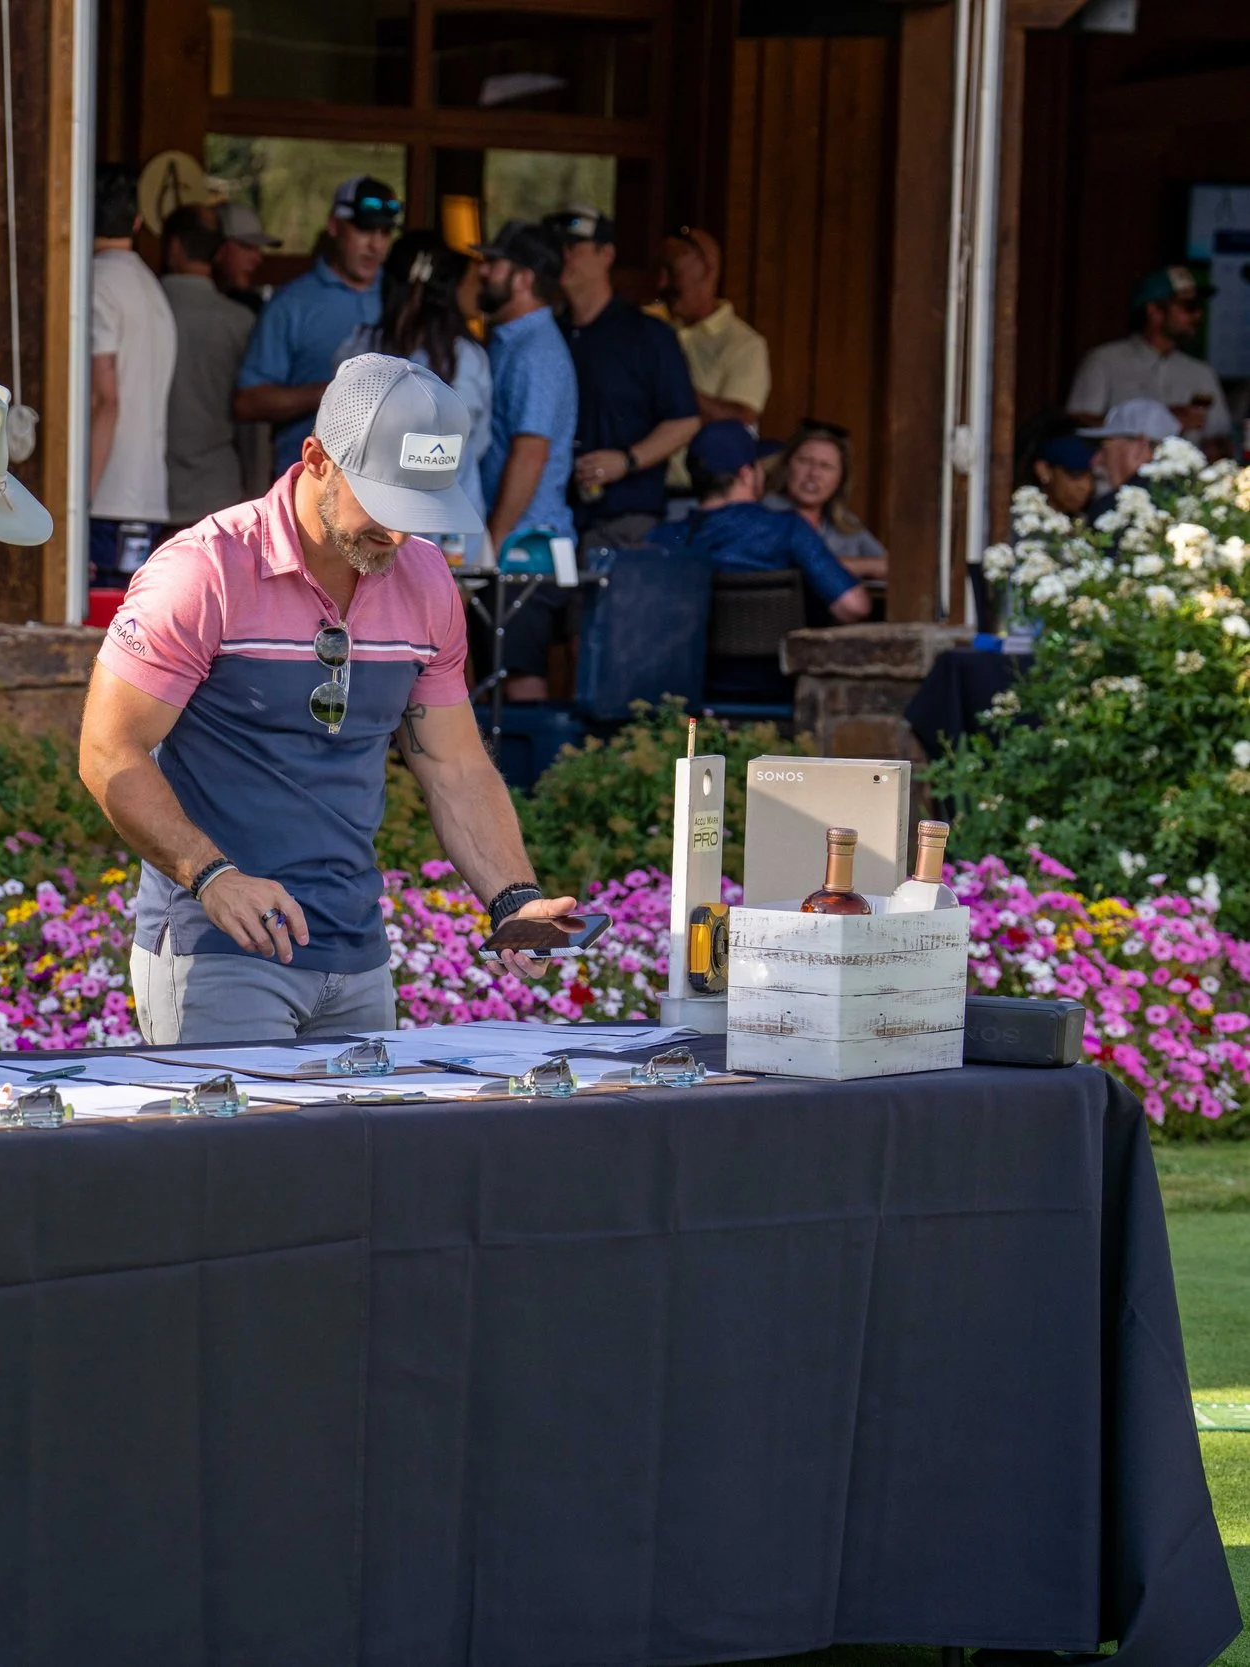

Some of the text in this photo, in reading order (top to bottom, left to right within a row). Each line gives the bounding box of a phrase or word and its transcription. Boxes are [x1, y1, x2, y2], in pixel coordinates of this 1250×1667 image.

[408, 454, 456, 465] PARAGON
[756, 771, 804, 782] SONOS
[693, 831, 719, 848] PRO
